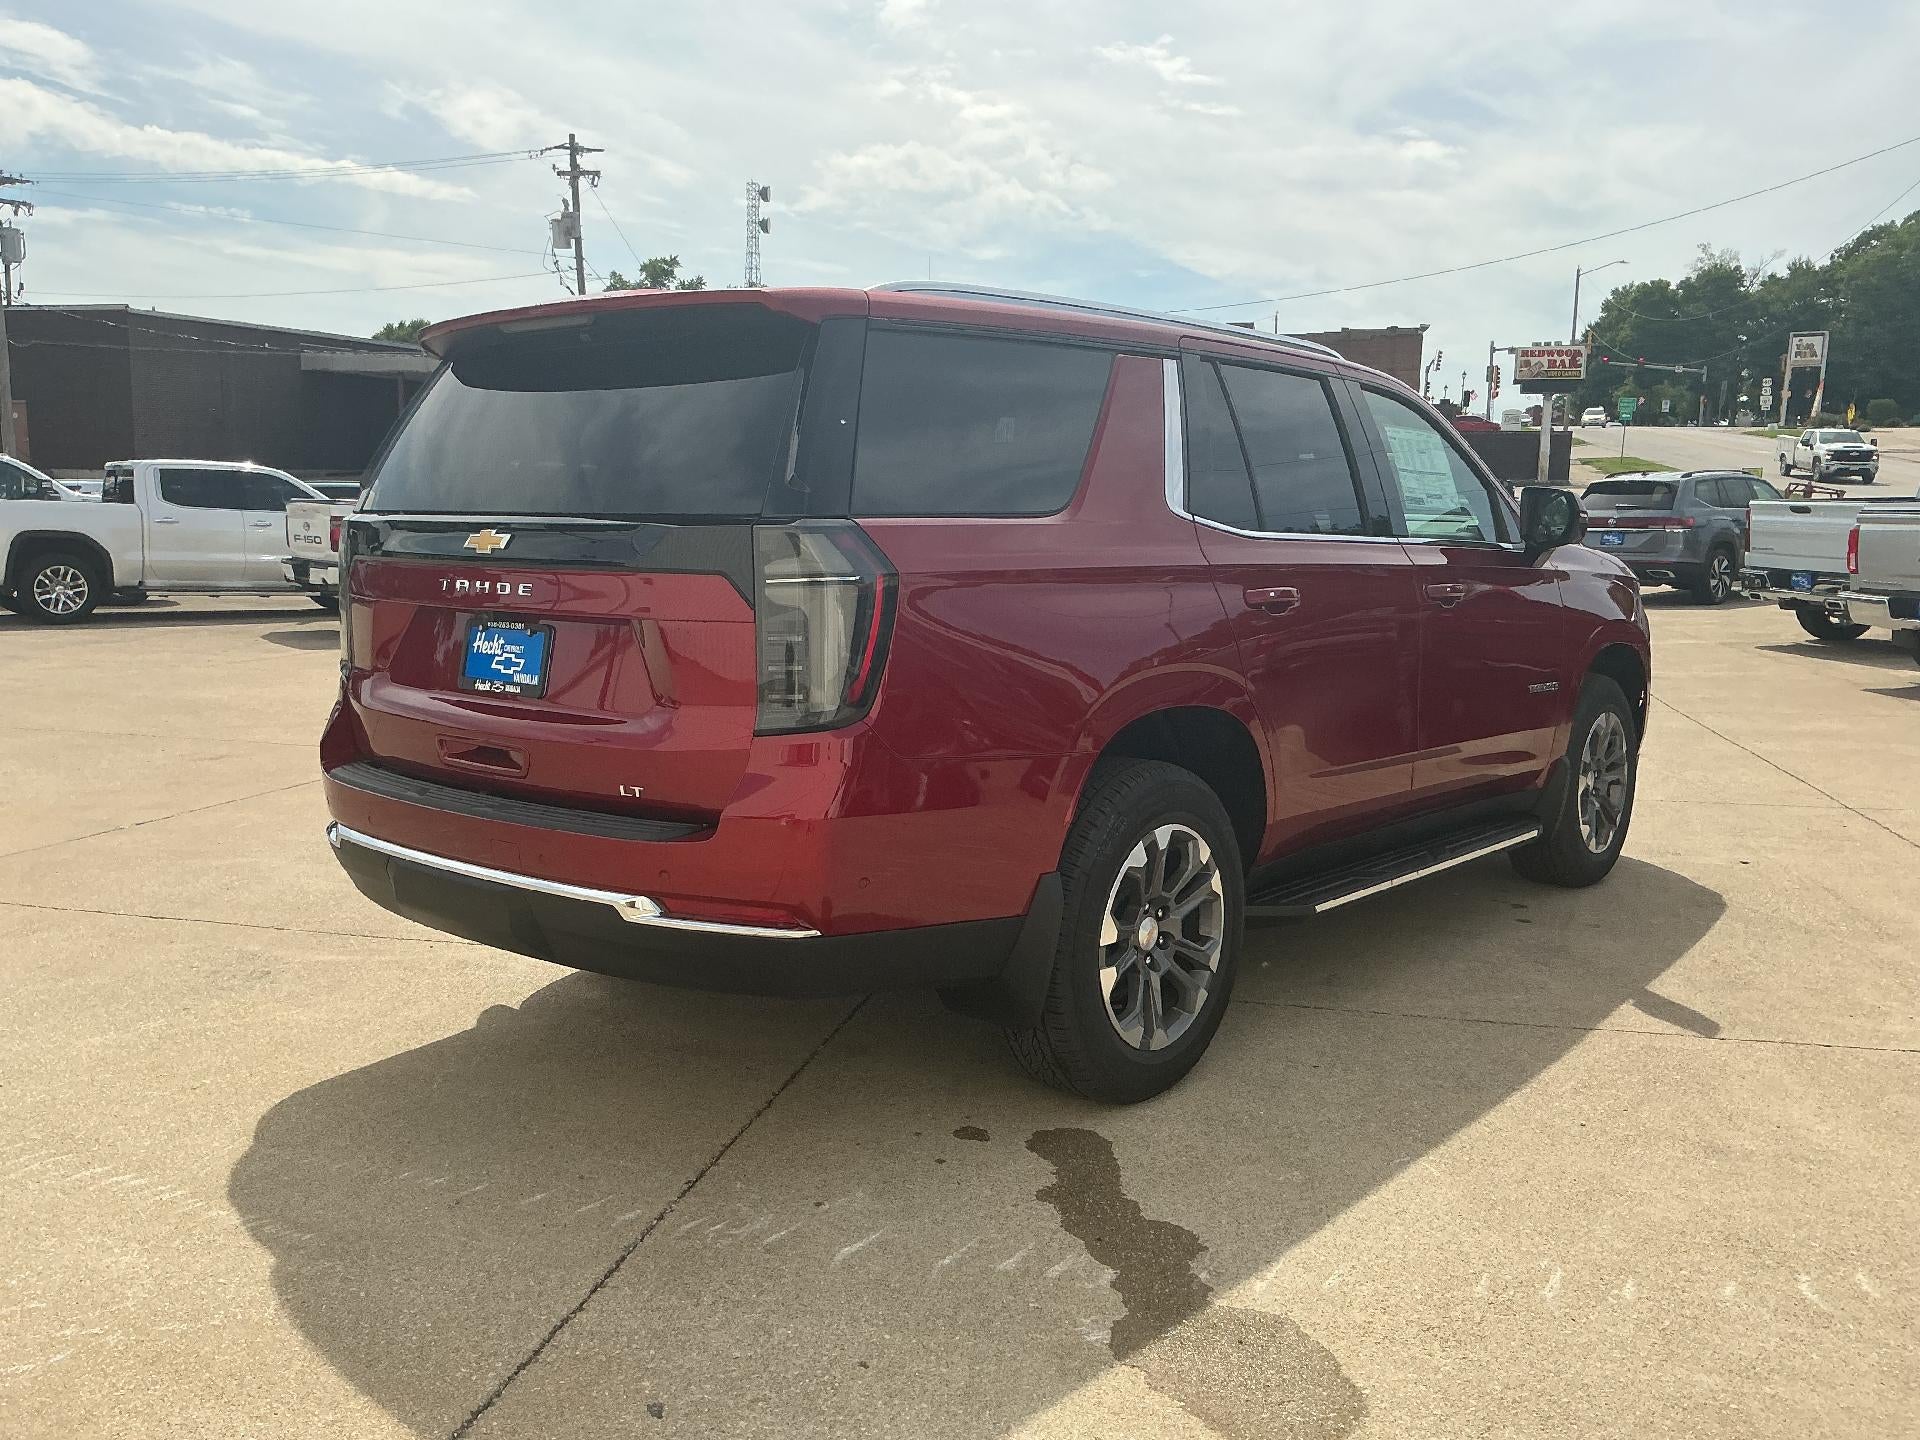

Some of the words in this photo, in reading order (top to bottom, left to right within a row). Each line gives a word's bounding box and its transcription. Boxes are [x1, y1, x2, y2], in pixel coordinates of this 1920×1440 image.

[1520, 349, 1583, 358] REDWOOD
[294, 534, 322, 544] F-150
[440, 579, 532, 596] TAHOE
[473, 632, 505, 655] Hecht
[513, 672, 538, 685] VANDALIA
[620, 785, 644, 797] LT
